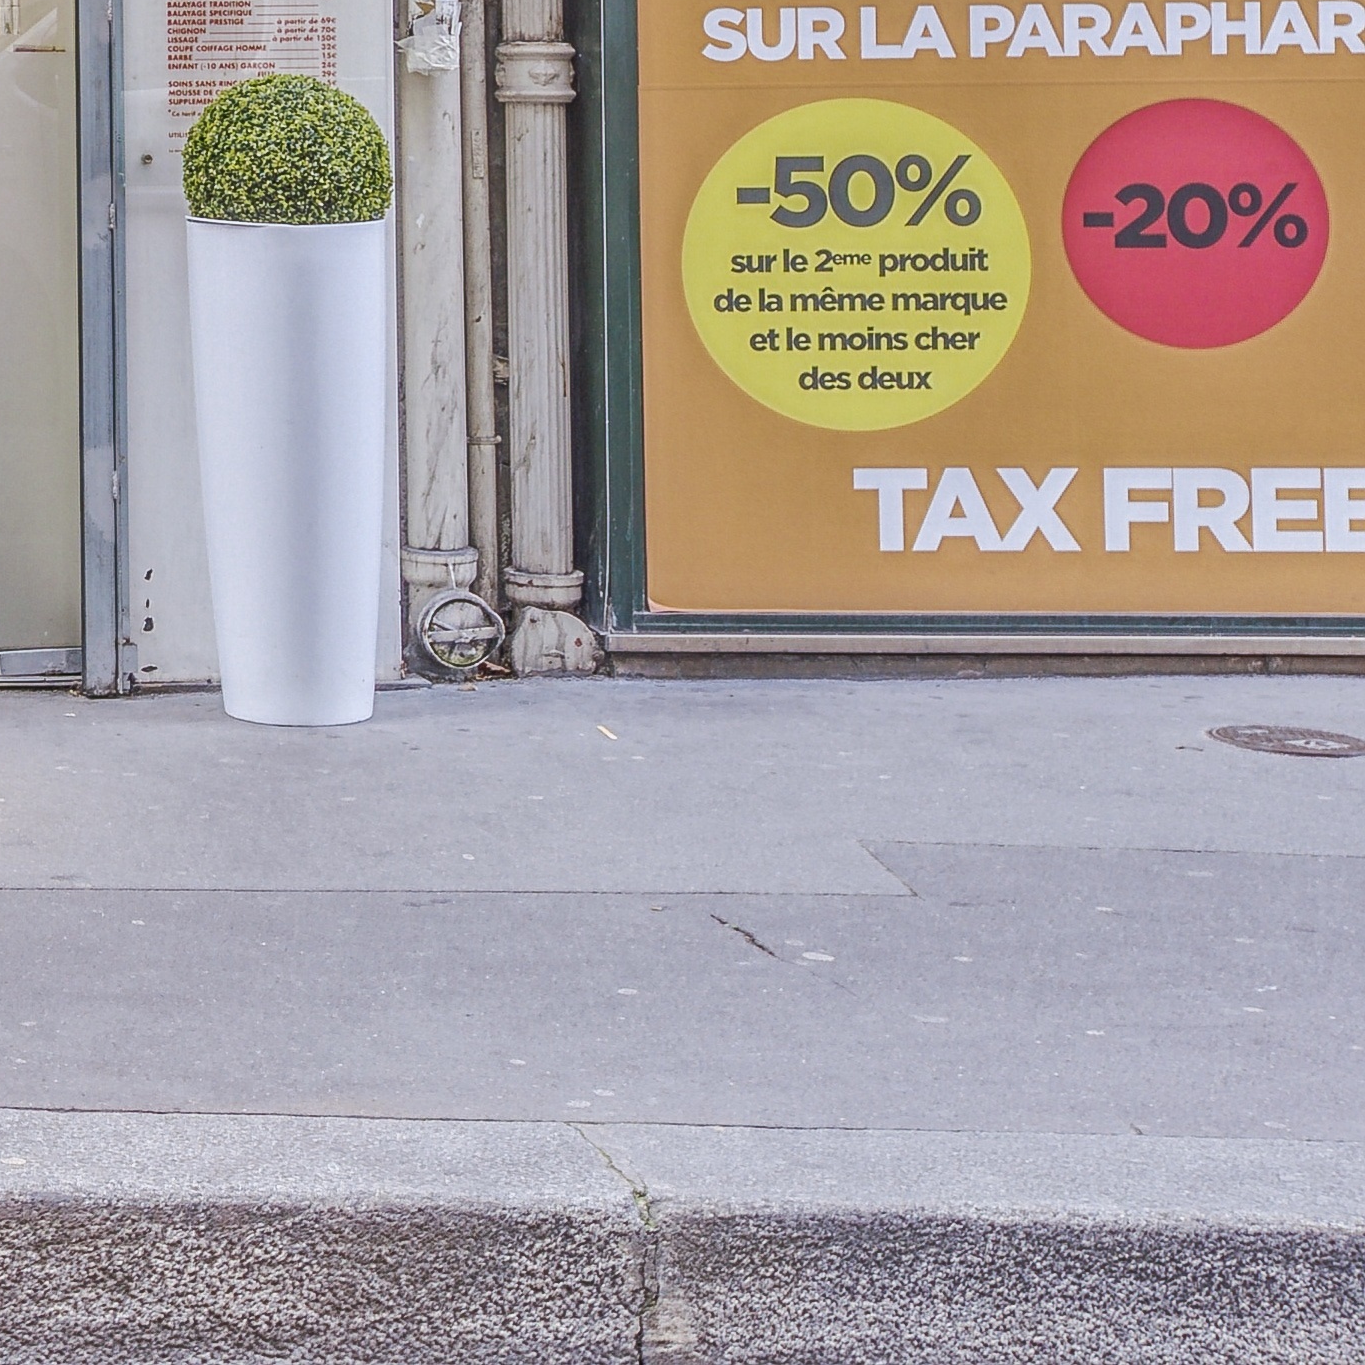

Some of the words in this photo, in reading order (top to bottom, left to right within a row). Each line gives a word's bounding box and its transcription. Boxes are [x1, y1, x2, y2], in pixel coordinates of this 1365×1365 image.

[702, 7, 846, 61] SUR
[860, 6, 957, 59] LA
[737, 154, 982, 228] -50%
[1083, 182, 1308, 249] -20%
[730, 254, 777, 273] sur
[783, 249, 808, 272] le
[814, 249, 871, 273] 2eme
[878, 247, 989, 277] produit
[714, 288, 752, 312] de
[759, 288, 783, 312] la
[790, 287, 885, 312] même
[892, 291, 1007, 316] marque
[749, 329, 779, 351] et
[786, 327, 811, 350] le
[818, 326, 908, 350] moins
[915, 326, 980, 350] cher
[799, 366, 851, 390] des
[858, 366, 932, 390] deux
[853, 467, 1081, 553] TAX
[1103, 467, 1365, 553] FREE
